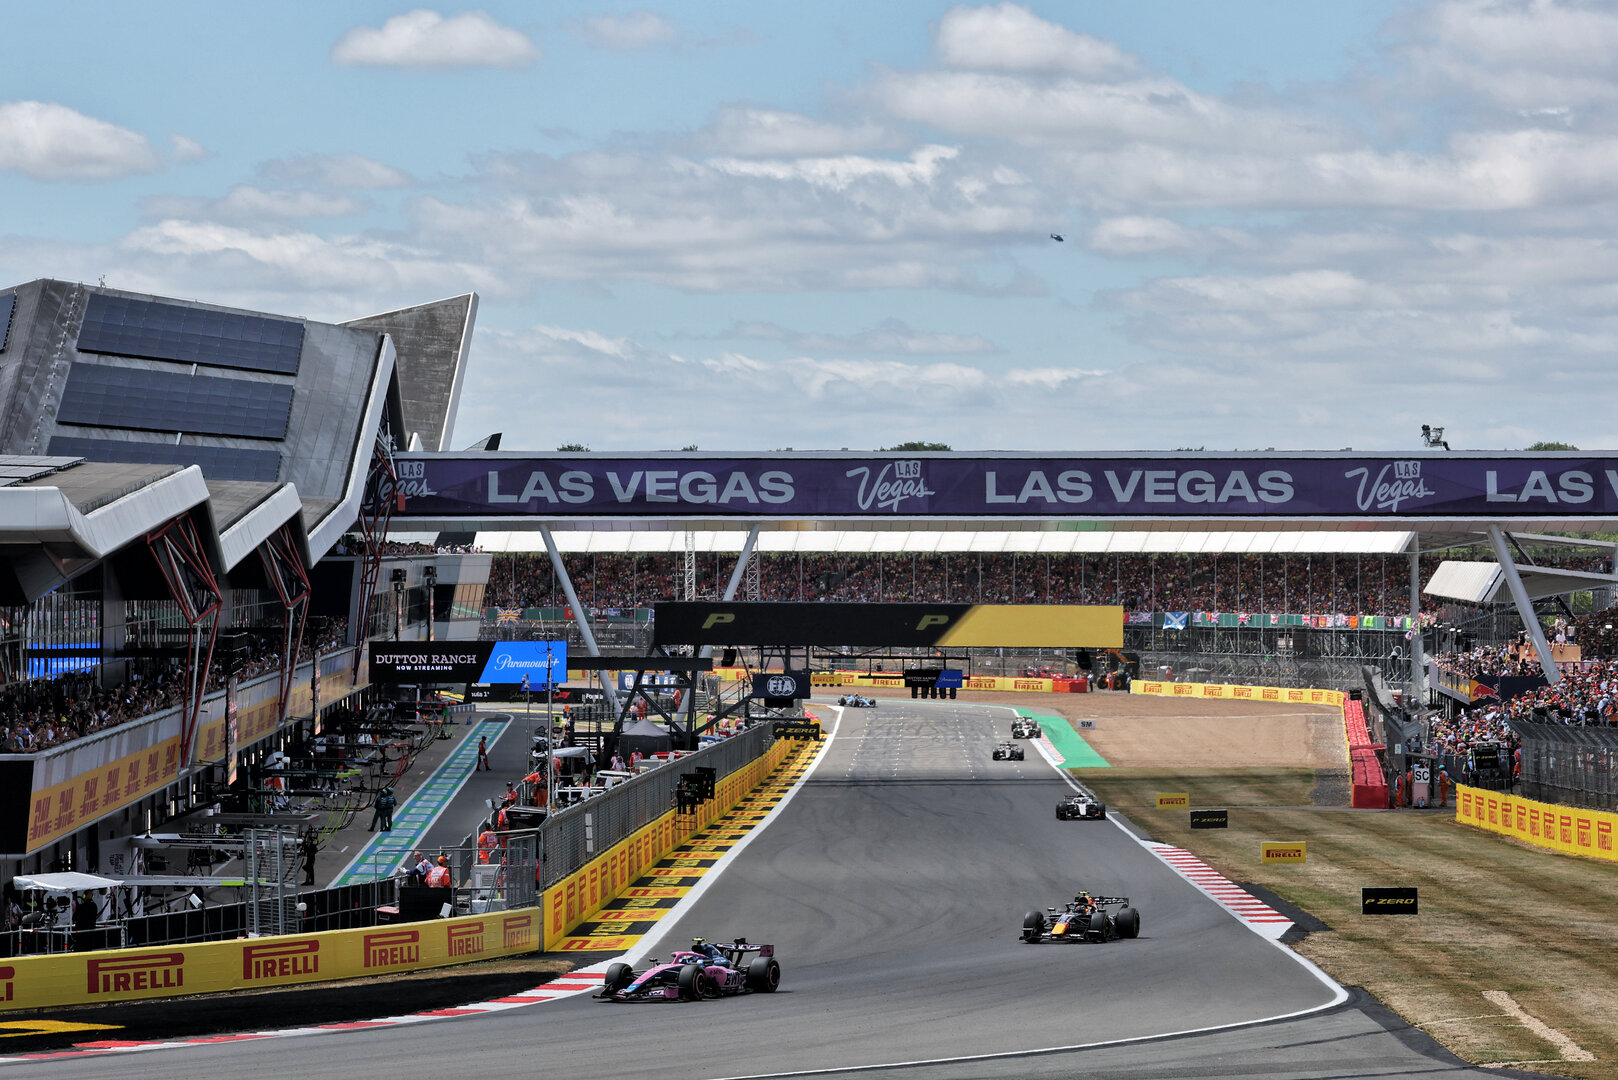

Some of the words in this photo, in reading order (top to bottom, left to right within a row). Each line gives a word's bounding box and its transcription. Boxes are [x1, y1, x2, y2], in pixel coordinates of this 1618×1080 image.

[399, 462, 424, 478] LAS
[896, 461, 921, 478] LAS
[1395, 461, 1421, 478] LAS
[488, 470, 595, 504] LAS
[606, 470, 796, 504] VEGAS
[846, 466, 935, 512] Vegas
[985, 470, 1094, 504] LAS
[1104, 470, 1295, 504] VEGAS
[1345, 463, 1435, 512] Vegas
[1486, 470, 1594, 504] LAS
[375, 654, 428, 664] DUTTON
[431, 654, 477, 664] RANCH
[966, 678, 996, 689] PIRELLI
[1014, 679, 1043, 690] PIRELLI
[1081, 720, 1093, 728] SM
[1415, 770, 1430, 781] SC
[1159, 797, 1186, 805] PIRELLI
[1266, 849, 1302, 858] PIRELLI
[448, 921, 484, 957] PIRELLI
[503, 915, 532, 949] PIRELLI
[243, 939, 319, 980] PIRELLI
[364, 930, 420, 968] PIRELLI
[88, 952, 185, 993] PIRELLI
